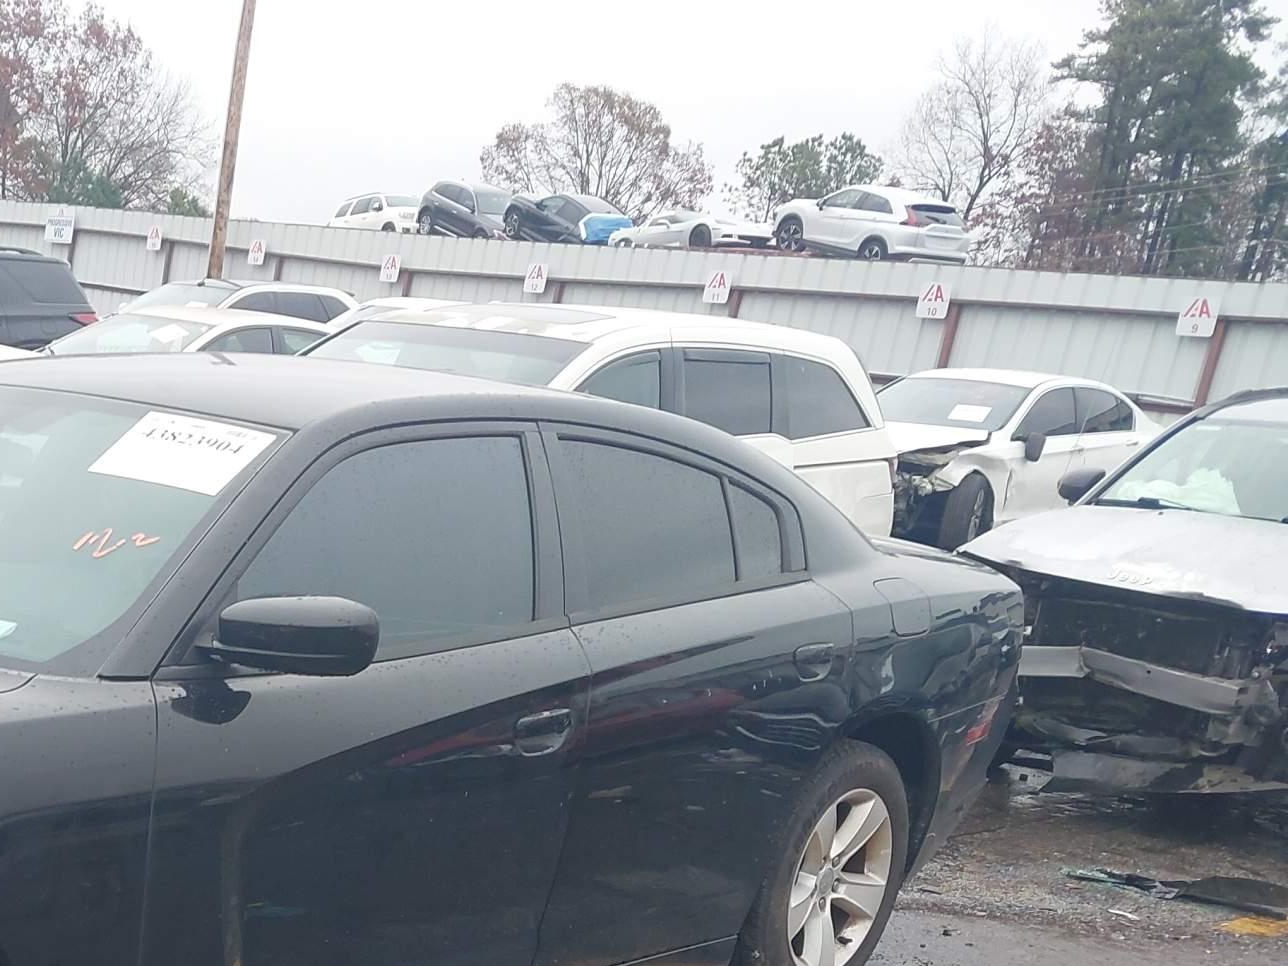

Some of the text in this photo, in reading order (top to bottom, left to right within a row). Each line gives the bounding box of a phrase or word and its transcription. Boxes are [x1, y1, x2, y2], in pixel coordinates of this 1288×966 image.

[926, 306, 937, 317] 10
[1191, 323, 1199, 334] 9
[143, 426, 245, 455] 43823904
